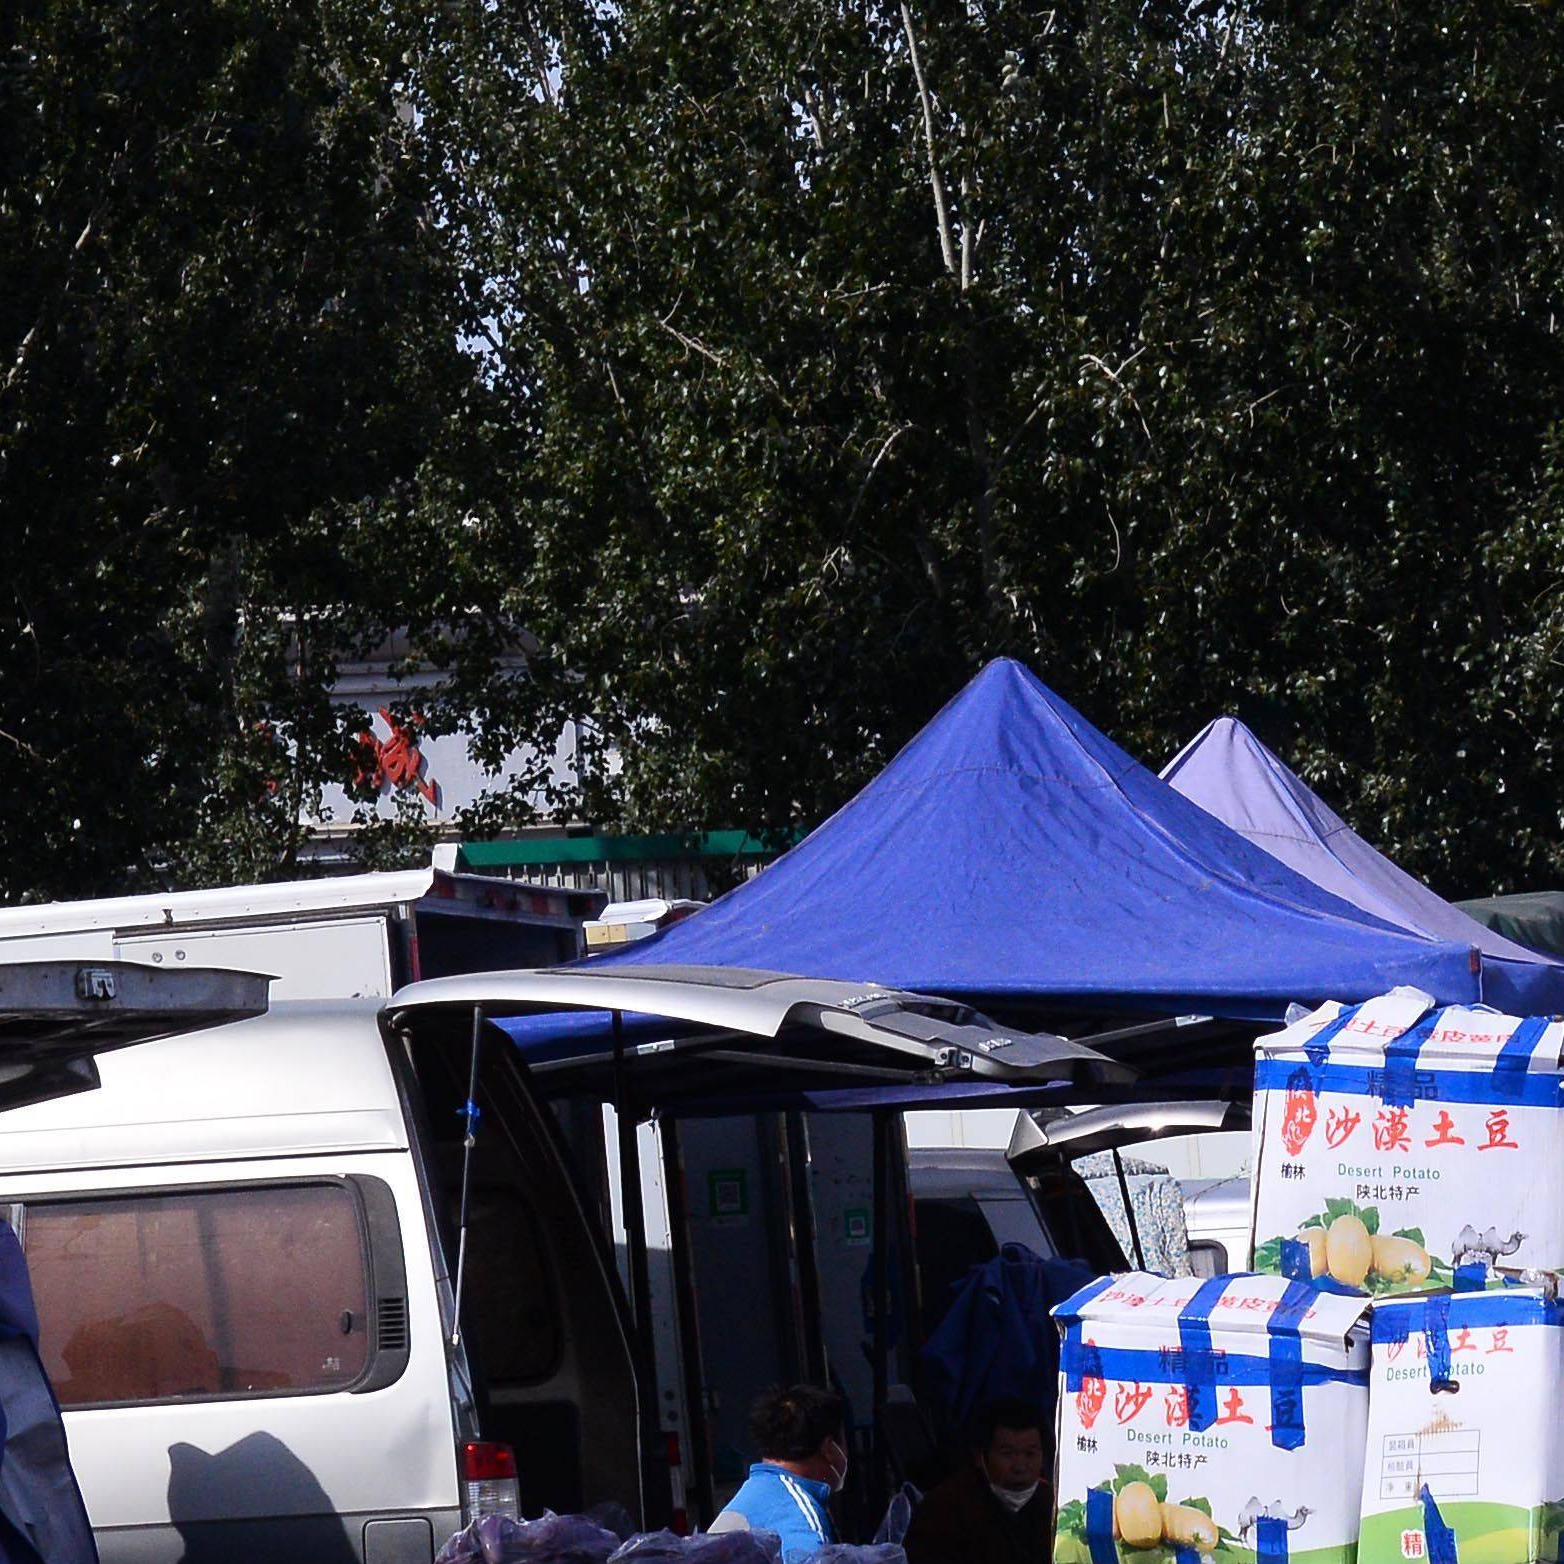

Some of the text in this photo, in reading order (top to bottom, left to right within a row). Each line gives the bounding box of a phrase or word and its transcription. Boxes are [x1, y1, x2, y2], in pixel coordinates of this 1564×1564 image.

[1326, 1106, 1518, 1152] 沙漠土豆
[1281, 1162, 1306, 1180] 榆林
[1338, 1163, 1440, 1180] Desert Potato
[1357, 1184, 1420, 1200] 陕北特产
[1387, 1362, 1485, 1383] Desert otato
[1115, 1380, 1305, 1432] 沙漠土豆
[1077, 1435, 1098, 1453] 榆林
[1127, 1428, 1228, 1449] Desert Potato
[1146, 1451, 1208, 1468] 陕北特产
